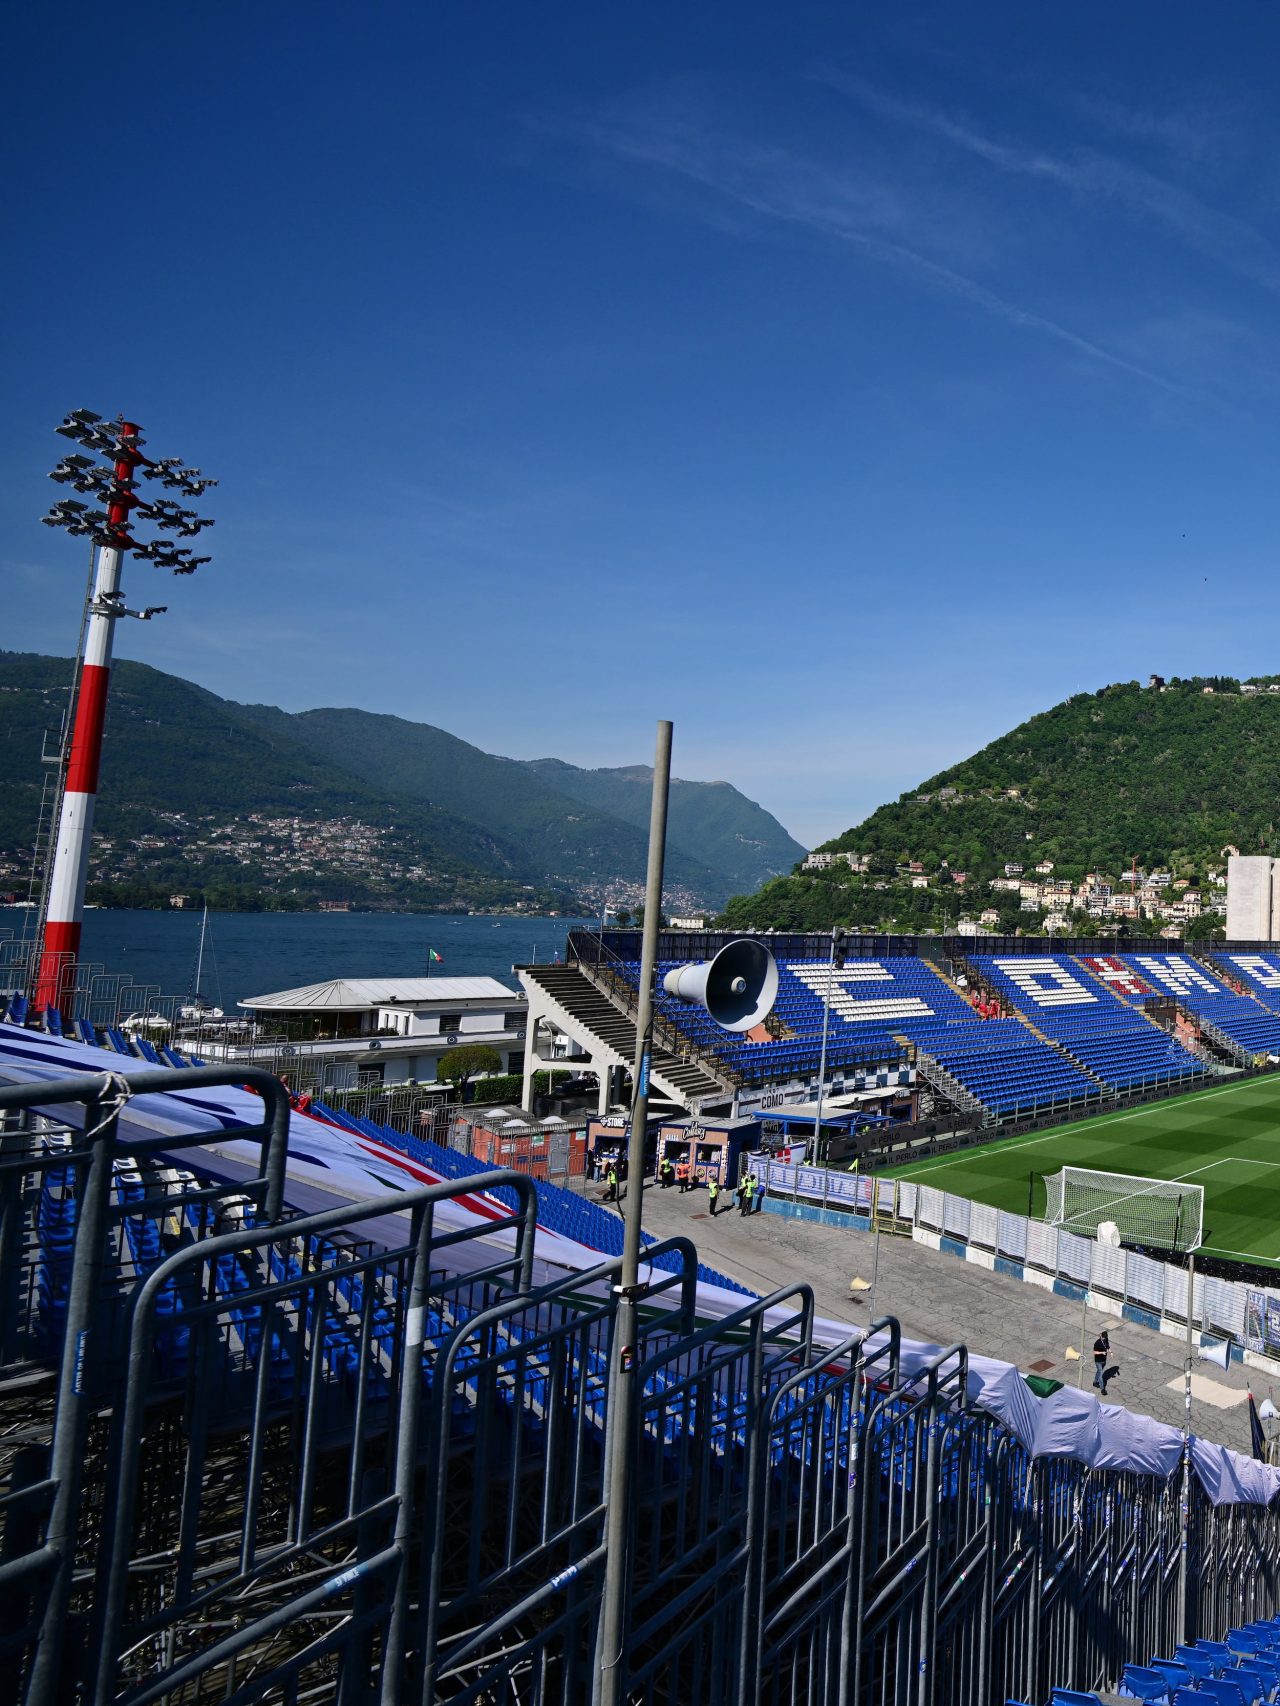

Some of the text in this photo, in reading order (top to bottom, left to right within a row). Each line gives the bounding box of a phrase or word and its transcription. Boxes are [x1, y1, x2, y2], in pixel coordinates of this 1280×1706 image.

[761, 1093, 784, 1109] COMO
[607, 1117, 625, 1128] STORE
[938, 1141, 958, 1153] PERLO
[896, 1150, 918, 1162] PERLO
